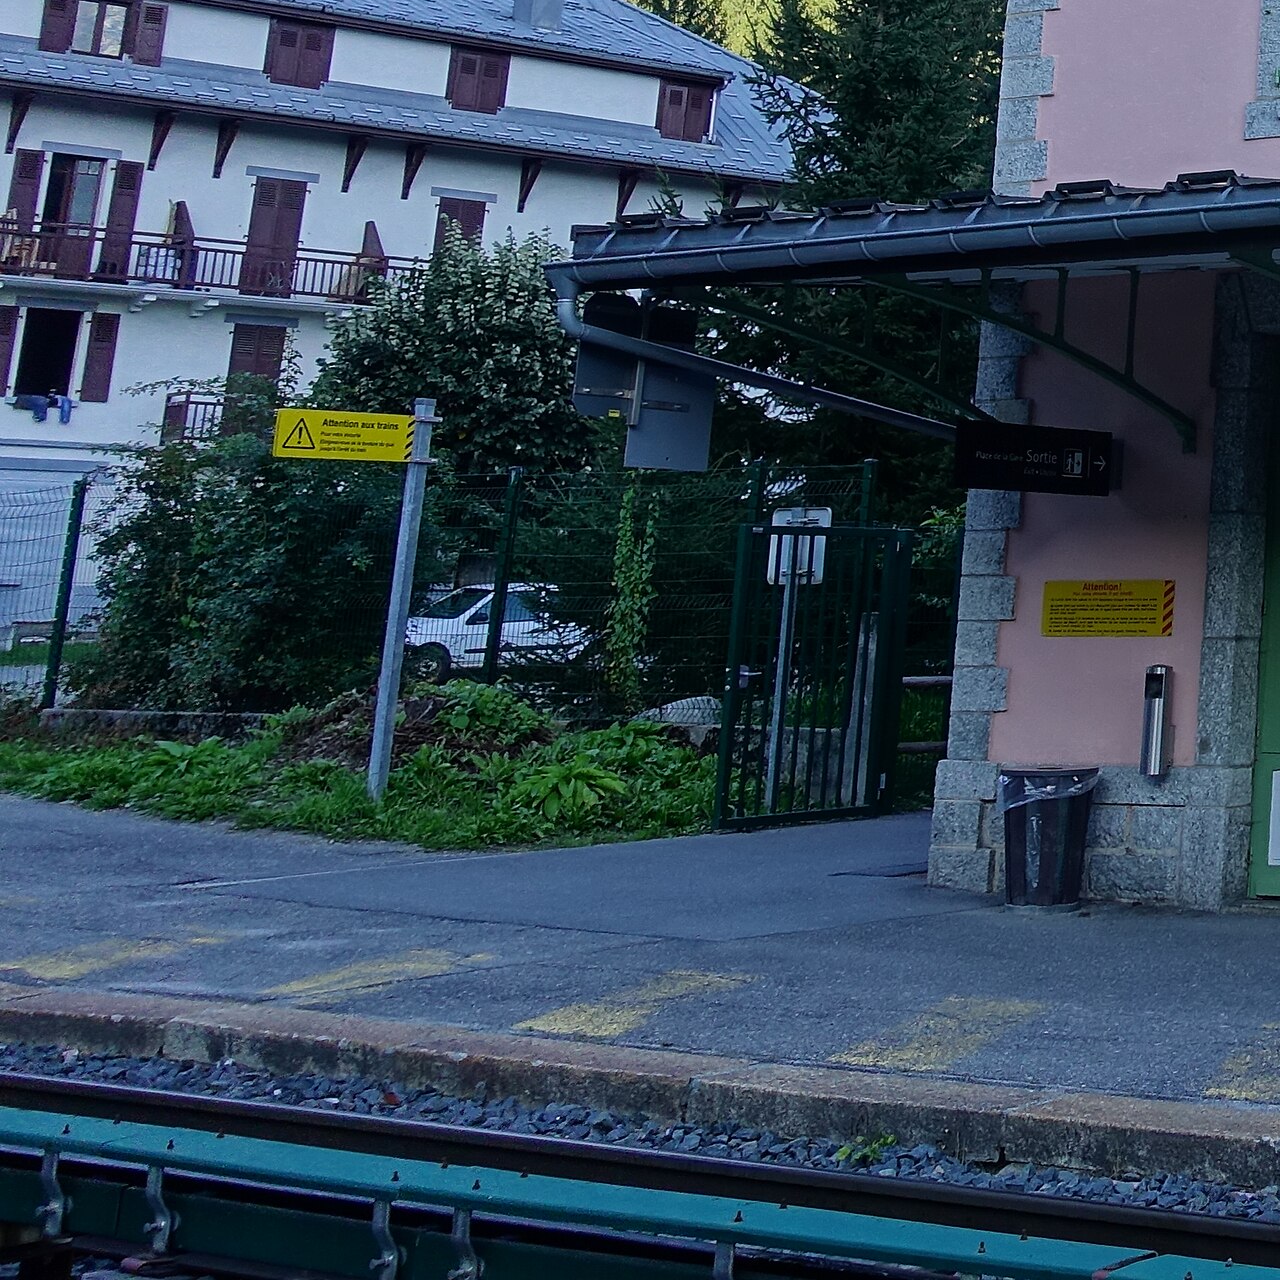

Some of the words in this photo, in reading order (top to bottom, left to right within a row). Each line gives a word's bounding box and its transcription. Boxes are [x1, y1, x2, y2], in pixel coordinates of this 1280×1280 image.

[322, 418, 359, 428] Attention
[361, 421, 376, 430] aux
[377, 422, 399, 431] trains
[1026, 449, 1058, 464] Sortie
[1082, 582, 1122, 591] Attention!
